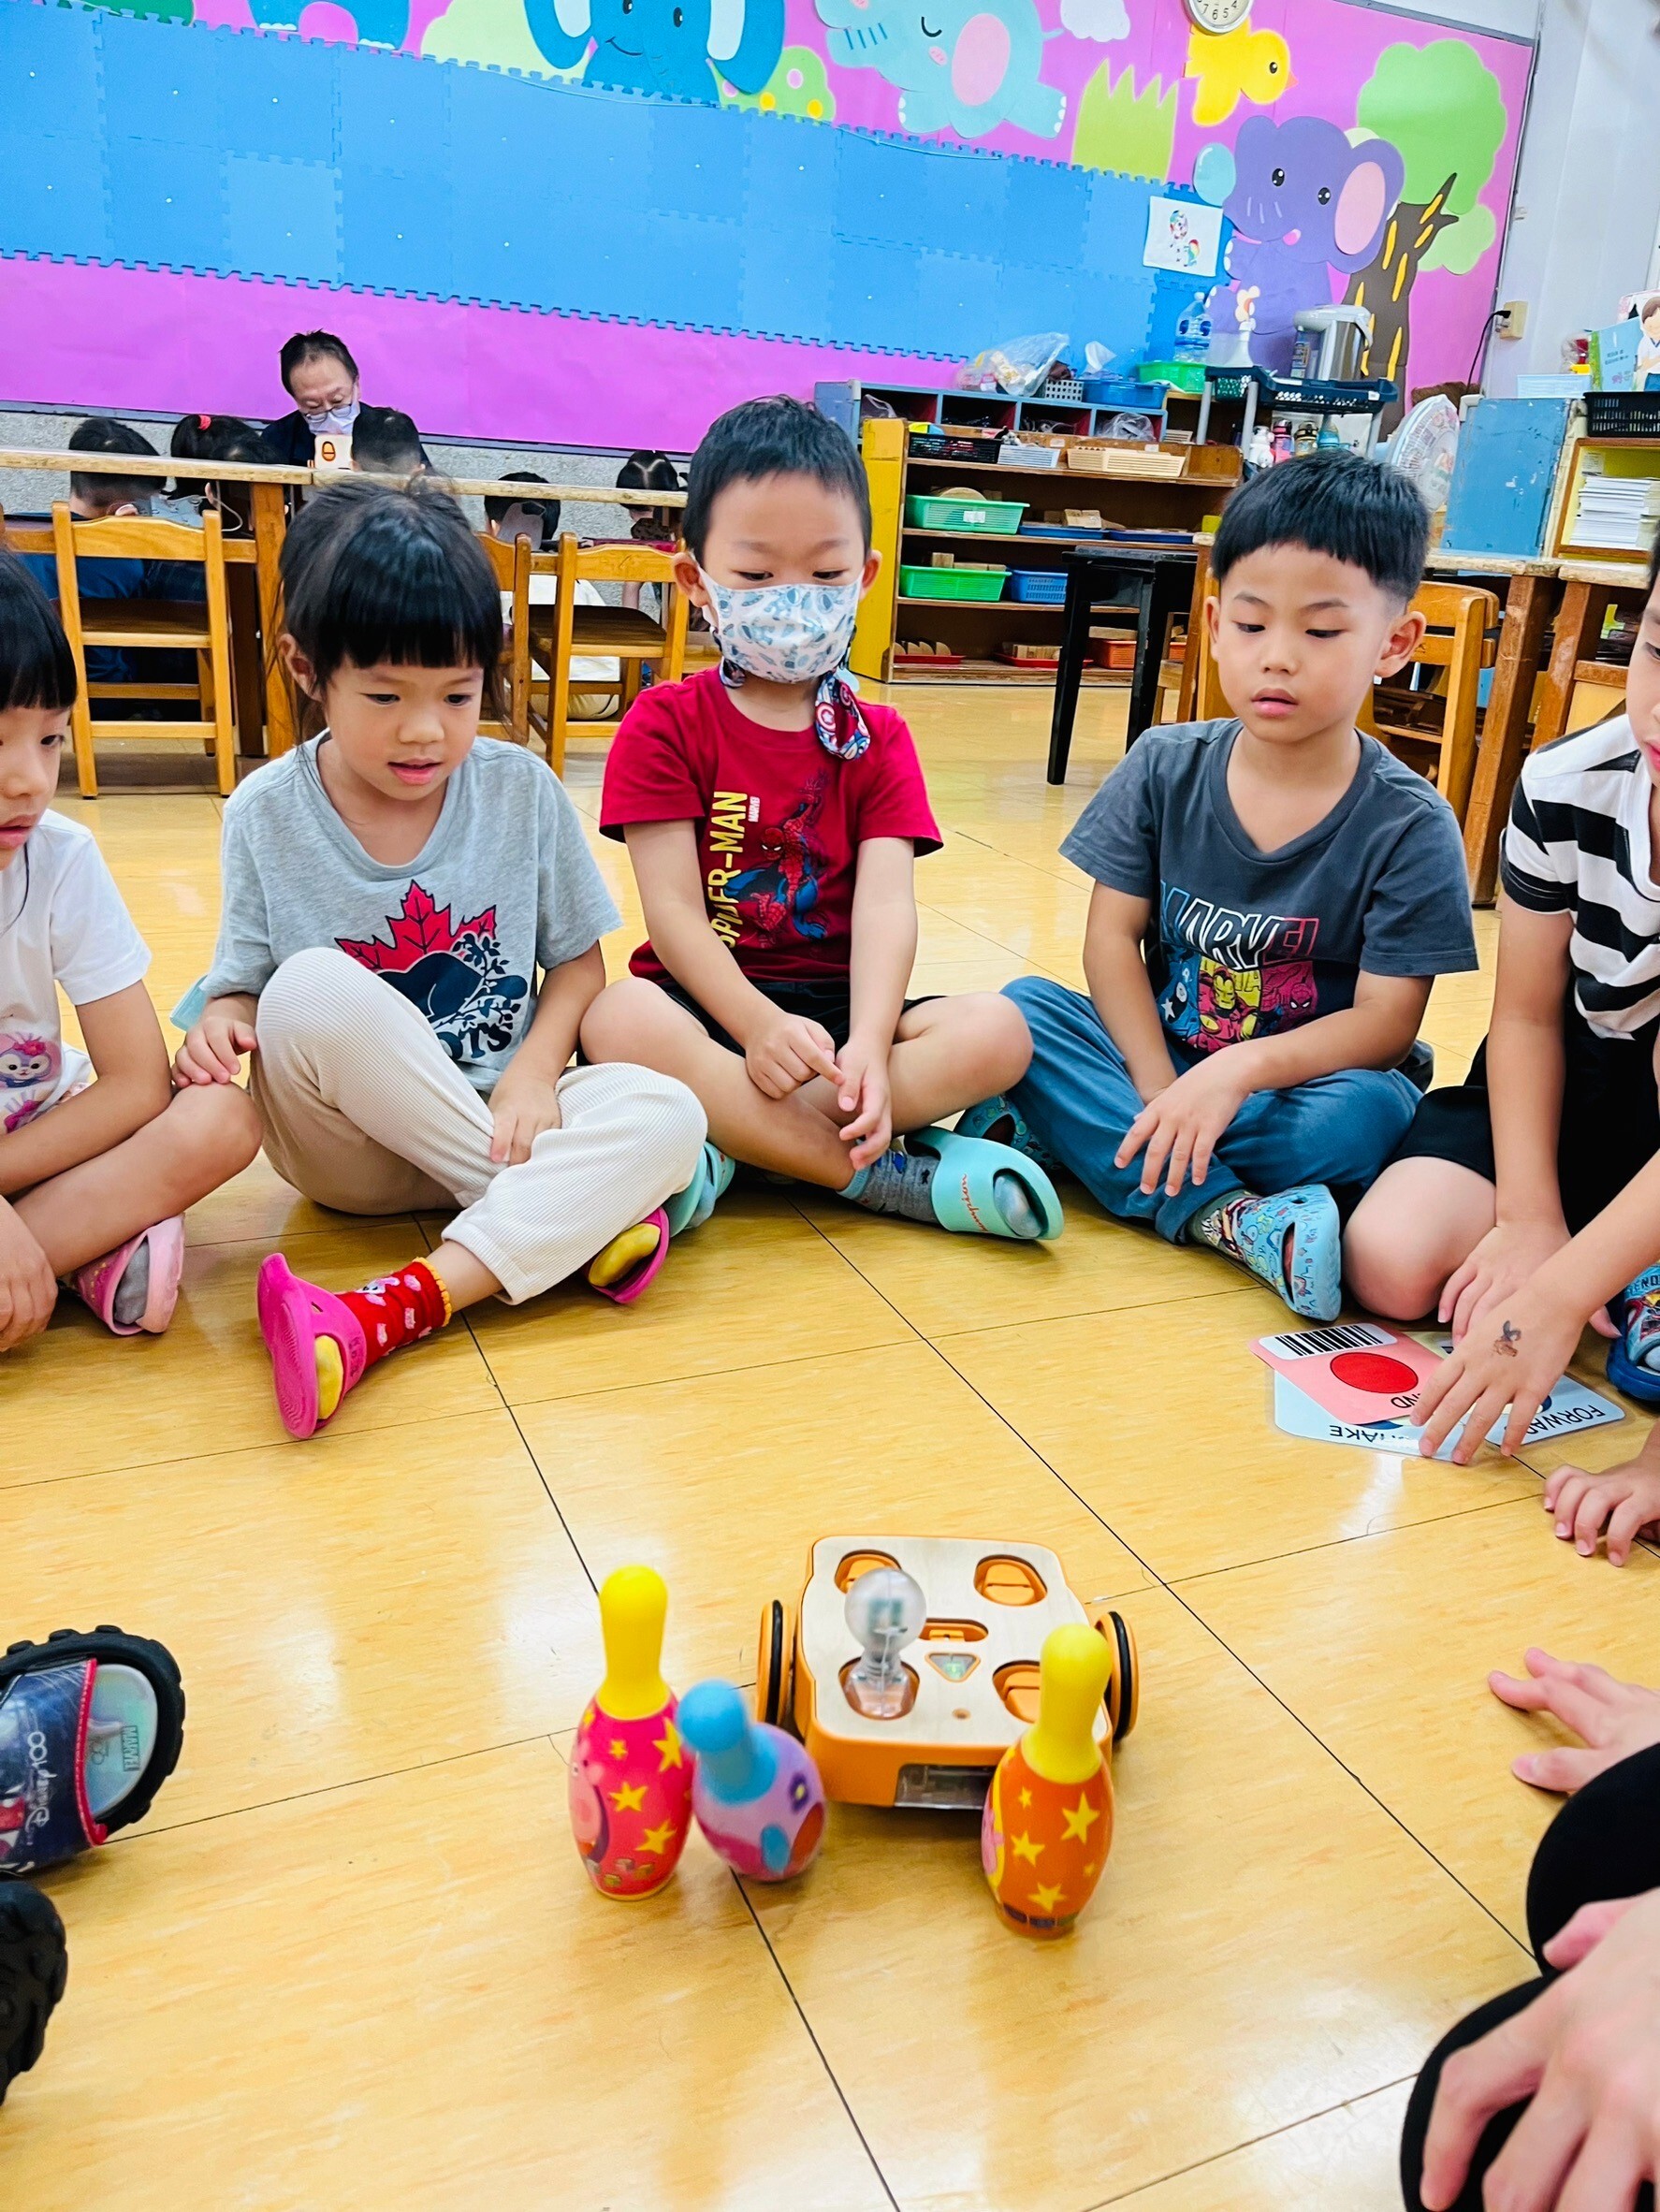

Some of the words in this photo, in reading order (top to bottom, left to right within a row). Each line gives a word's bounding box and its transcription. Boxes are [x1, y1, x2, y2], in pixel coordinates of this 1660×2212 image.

[1212, 8, 1218, 20] 6
[1222, 7, 1230, 19] 5
[1391, 1393, 1420, 1409] ND
[1526, 1404, 1606, 1434] FORWA
